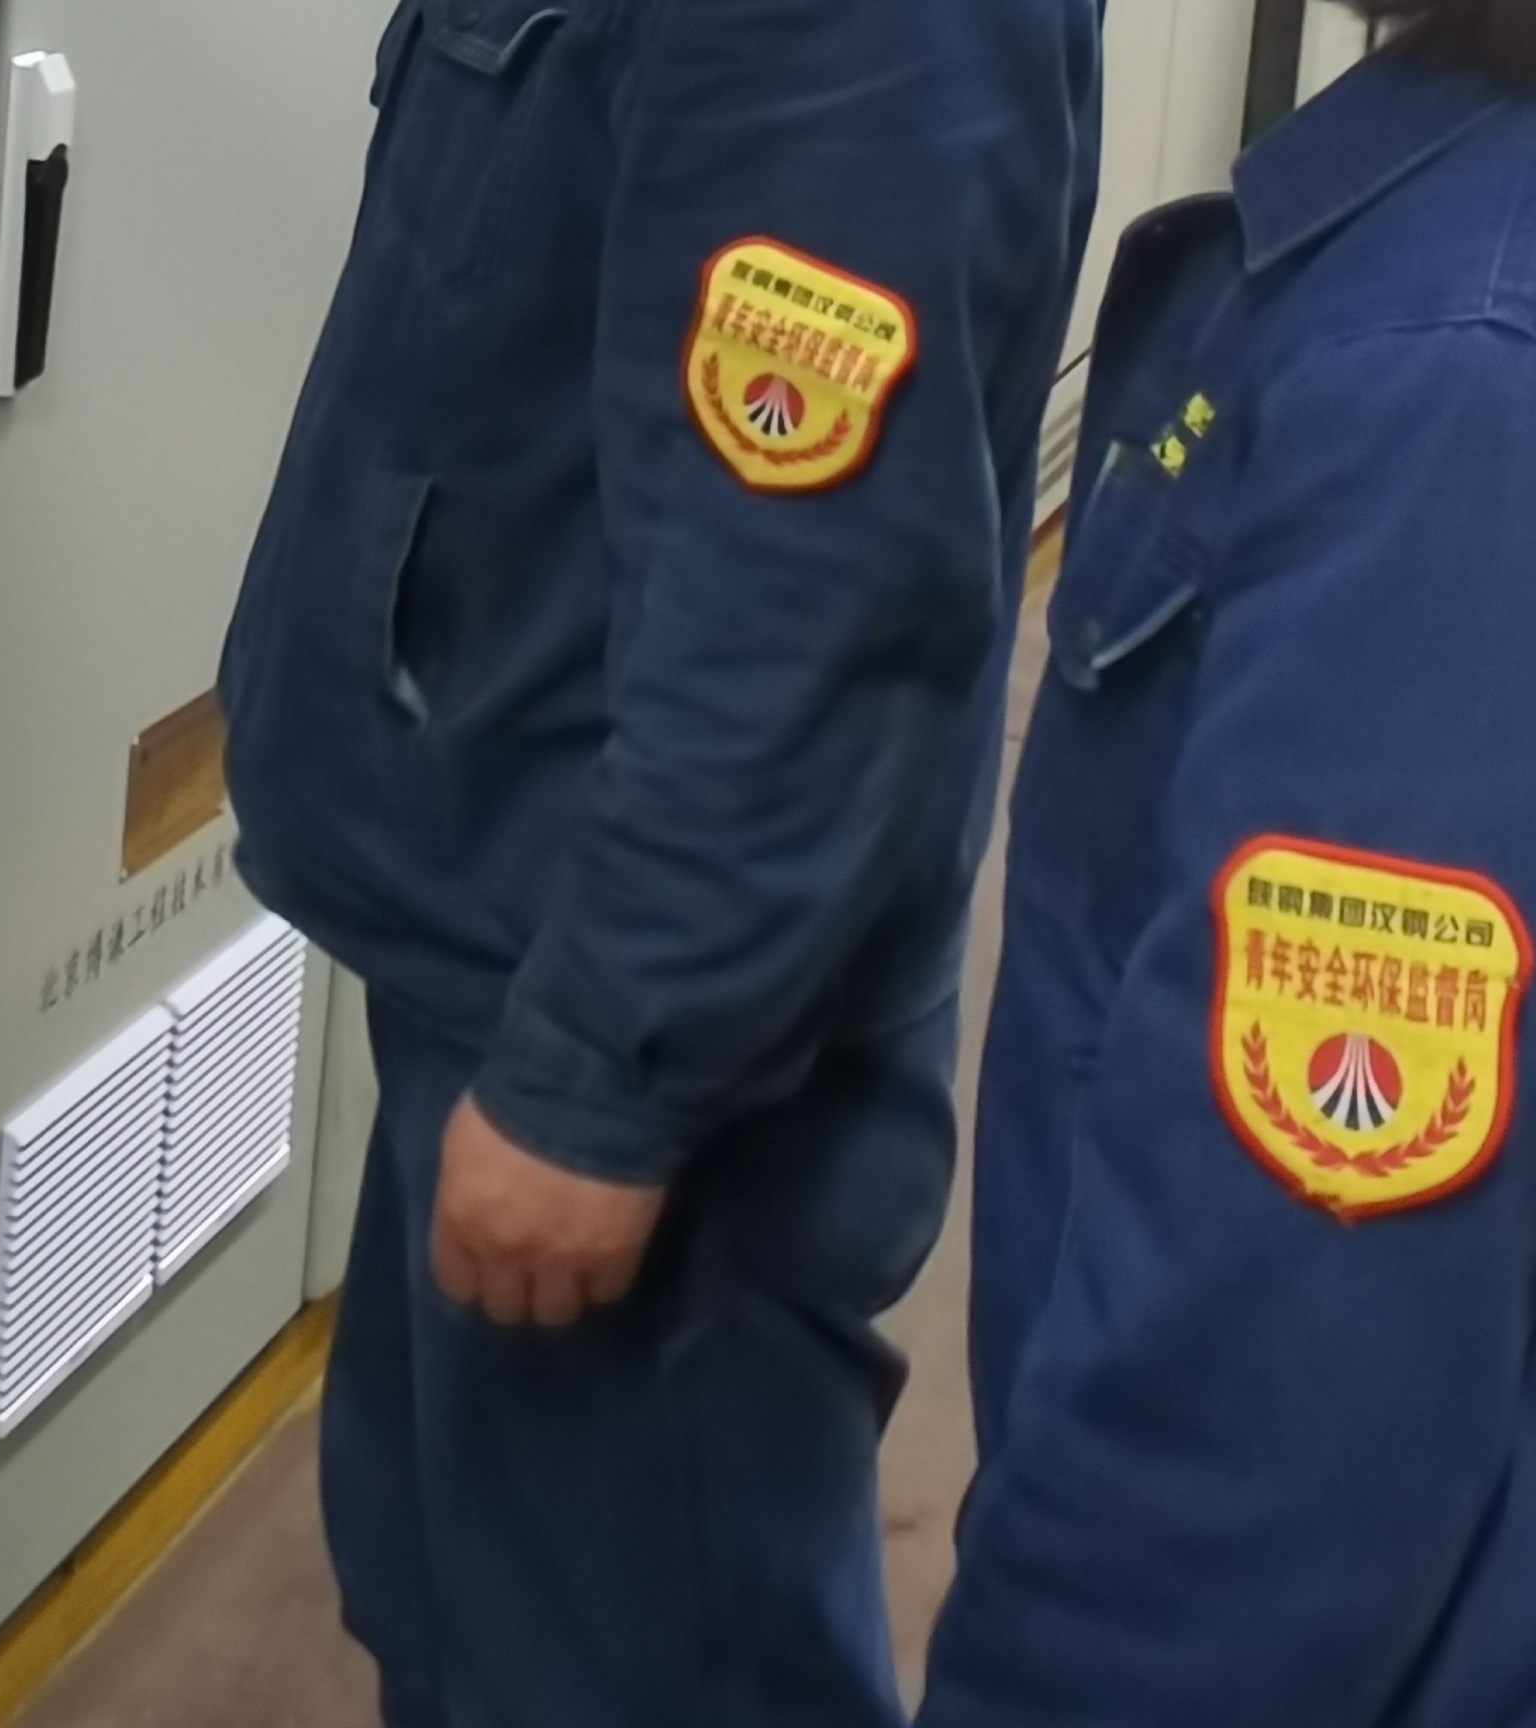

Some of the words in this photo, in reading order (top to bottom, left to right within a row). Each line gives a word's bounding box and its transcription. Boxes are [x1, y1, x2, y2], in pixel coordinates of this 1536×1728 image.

[1245, 927, 1488, 1033] 青年安全环保监督岗
